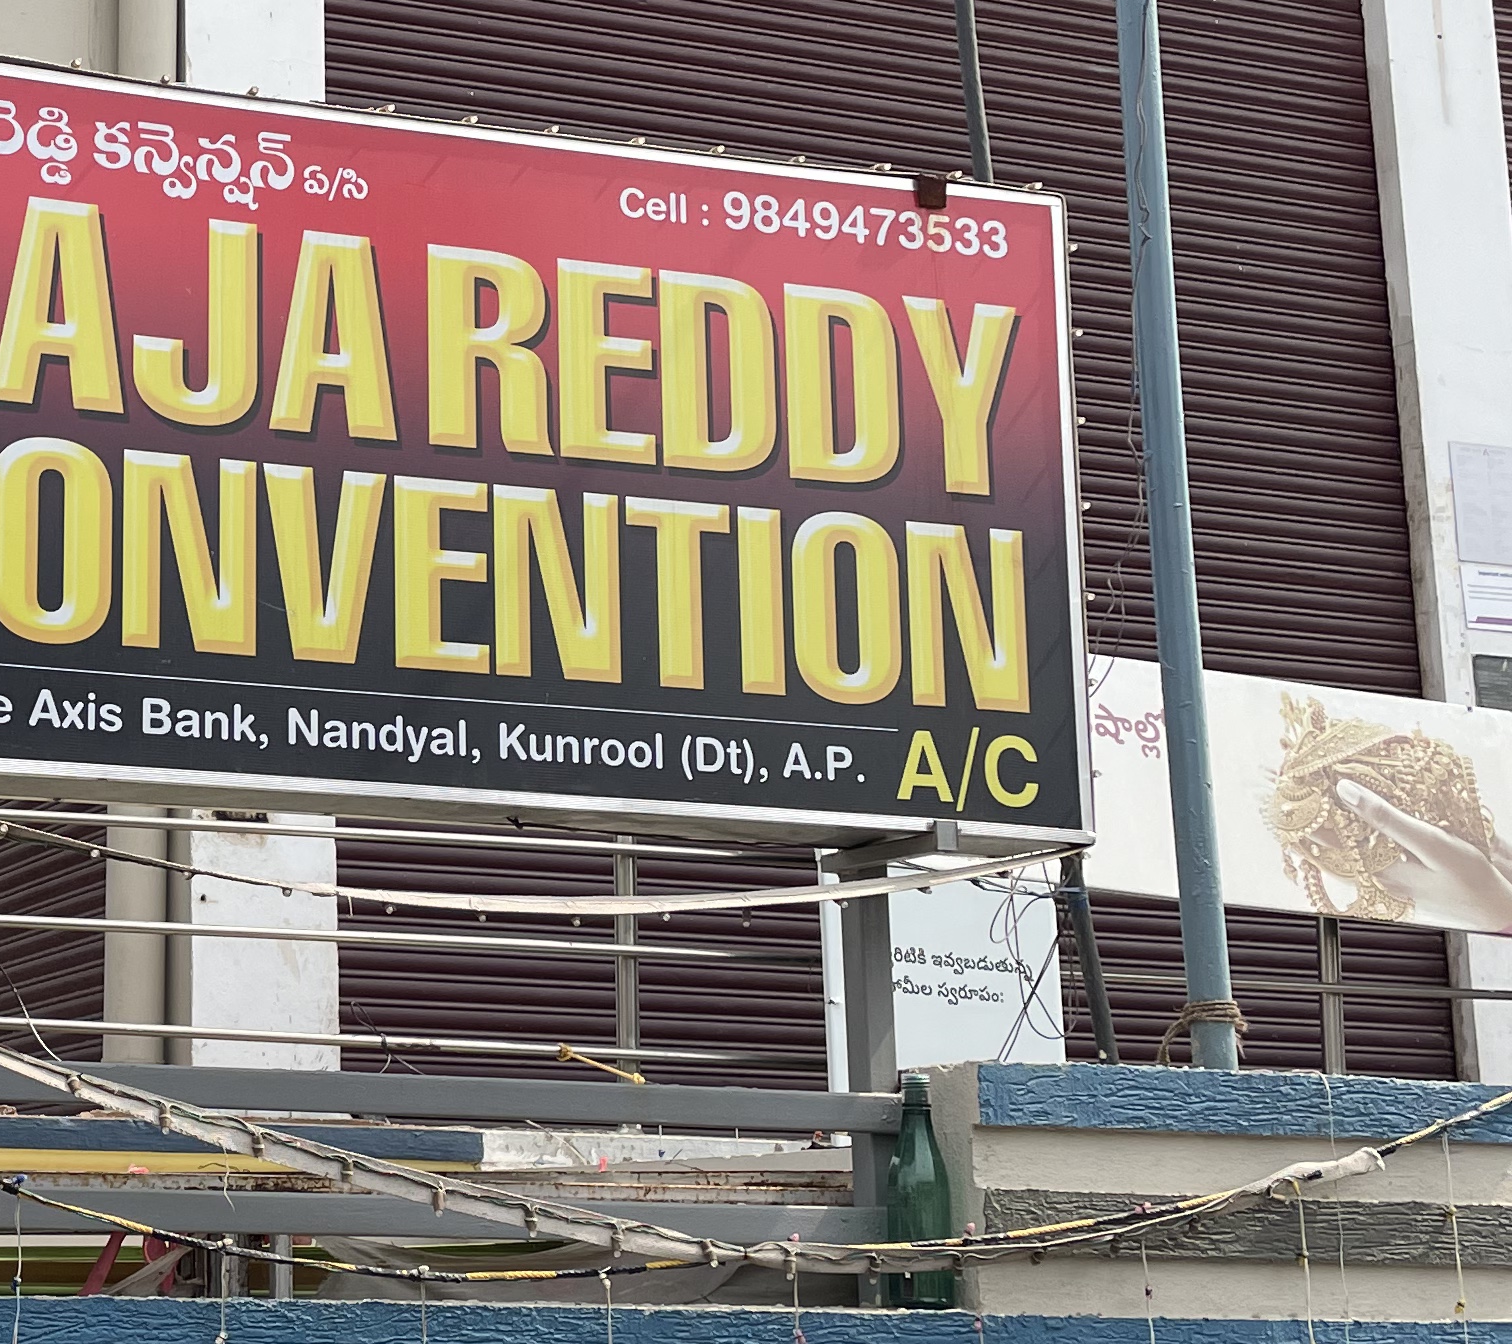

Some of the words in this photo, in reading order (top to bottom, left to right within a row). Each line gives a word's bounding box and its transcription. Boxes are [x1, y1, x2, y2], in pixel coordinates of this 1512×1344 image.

[92, 120, 296, 211] కన్వెన్షన్
[619, 187, 687, 224] Cell
[723, 190, 1009, 259] 9849473533
[425, 241, 1020, 499] REDDY
[28, 688, 123, 733] Axis
[142, 697, 269, 750] Bank,
[287, 707, 481, 764] Nandyal,
[499, 722, 664, 771] Kunrool
[681, 734, 769, 785] (Dt),
[782, 742, 865, 783] A.P.
[897, 726, 1039, 812] A/C
